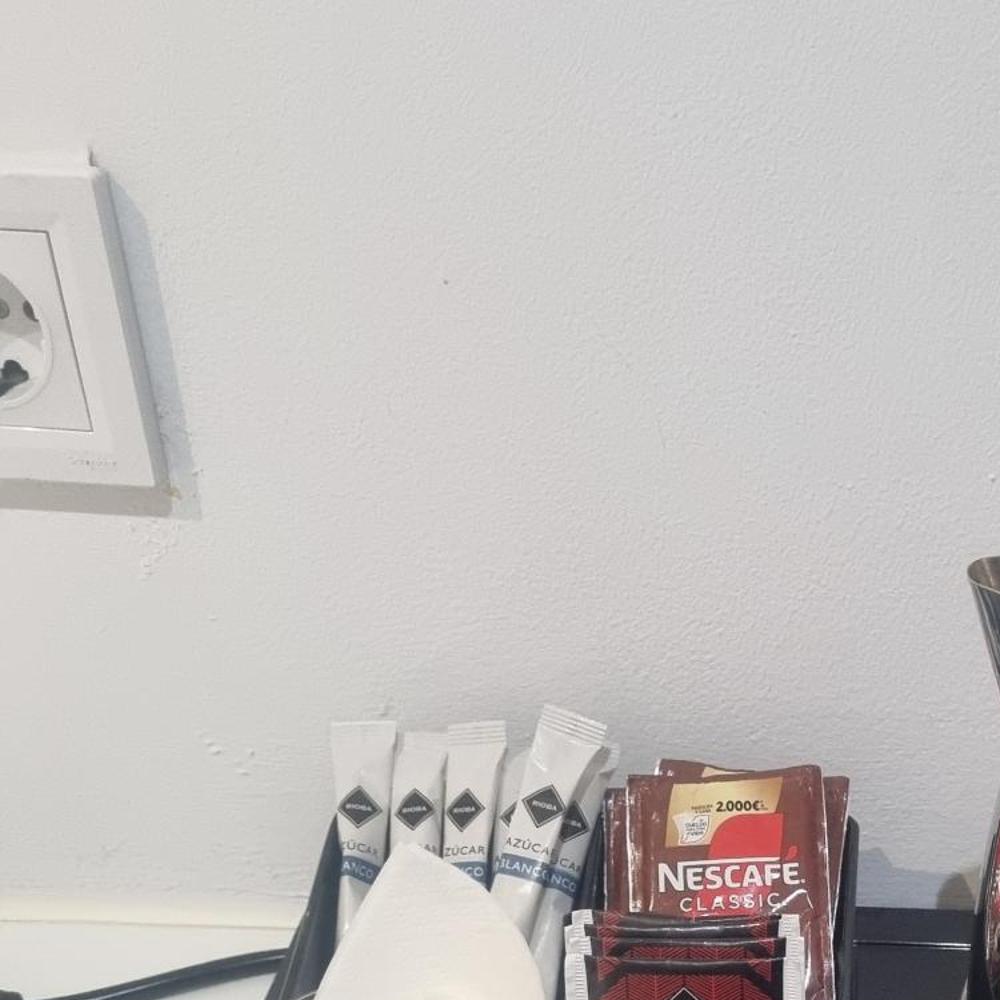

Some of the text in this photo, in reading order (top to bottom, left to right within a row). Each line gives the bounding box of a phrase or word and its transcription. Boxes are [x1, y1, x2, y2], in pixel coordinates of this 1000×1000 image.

[443, 843, 486, 858] ZÚCAR
[342, 860, 375, 879] ANCO
[679, 890, 782, 913] CLASSIC
